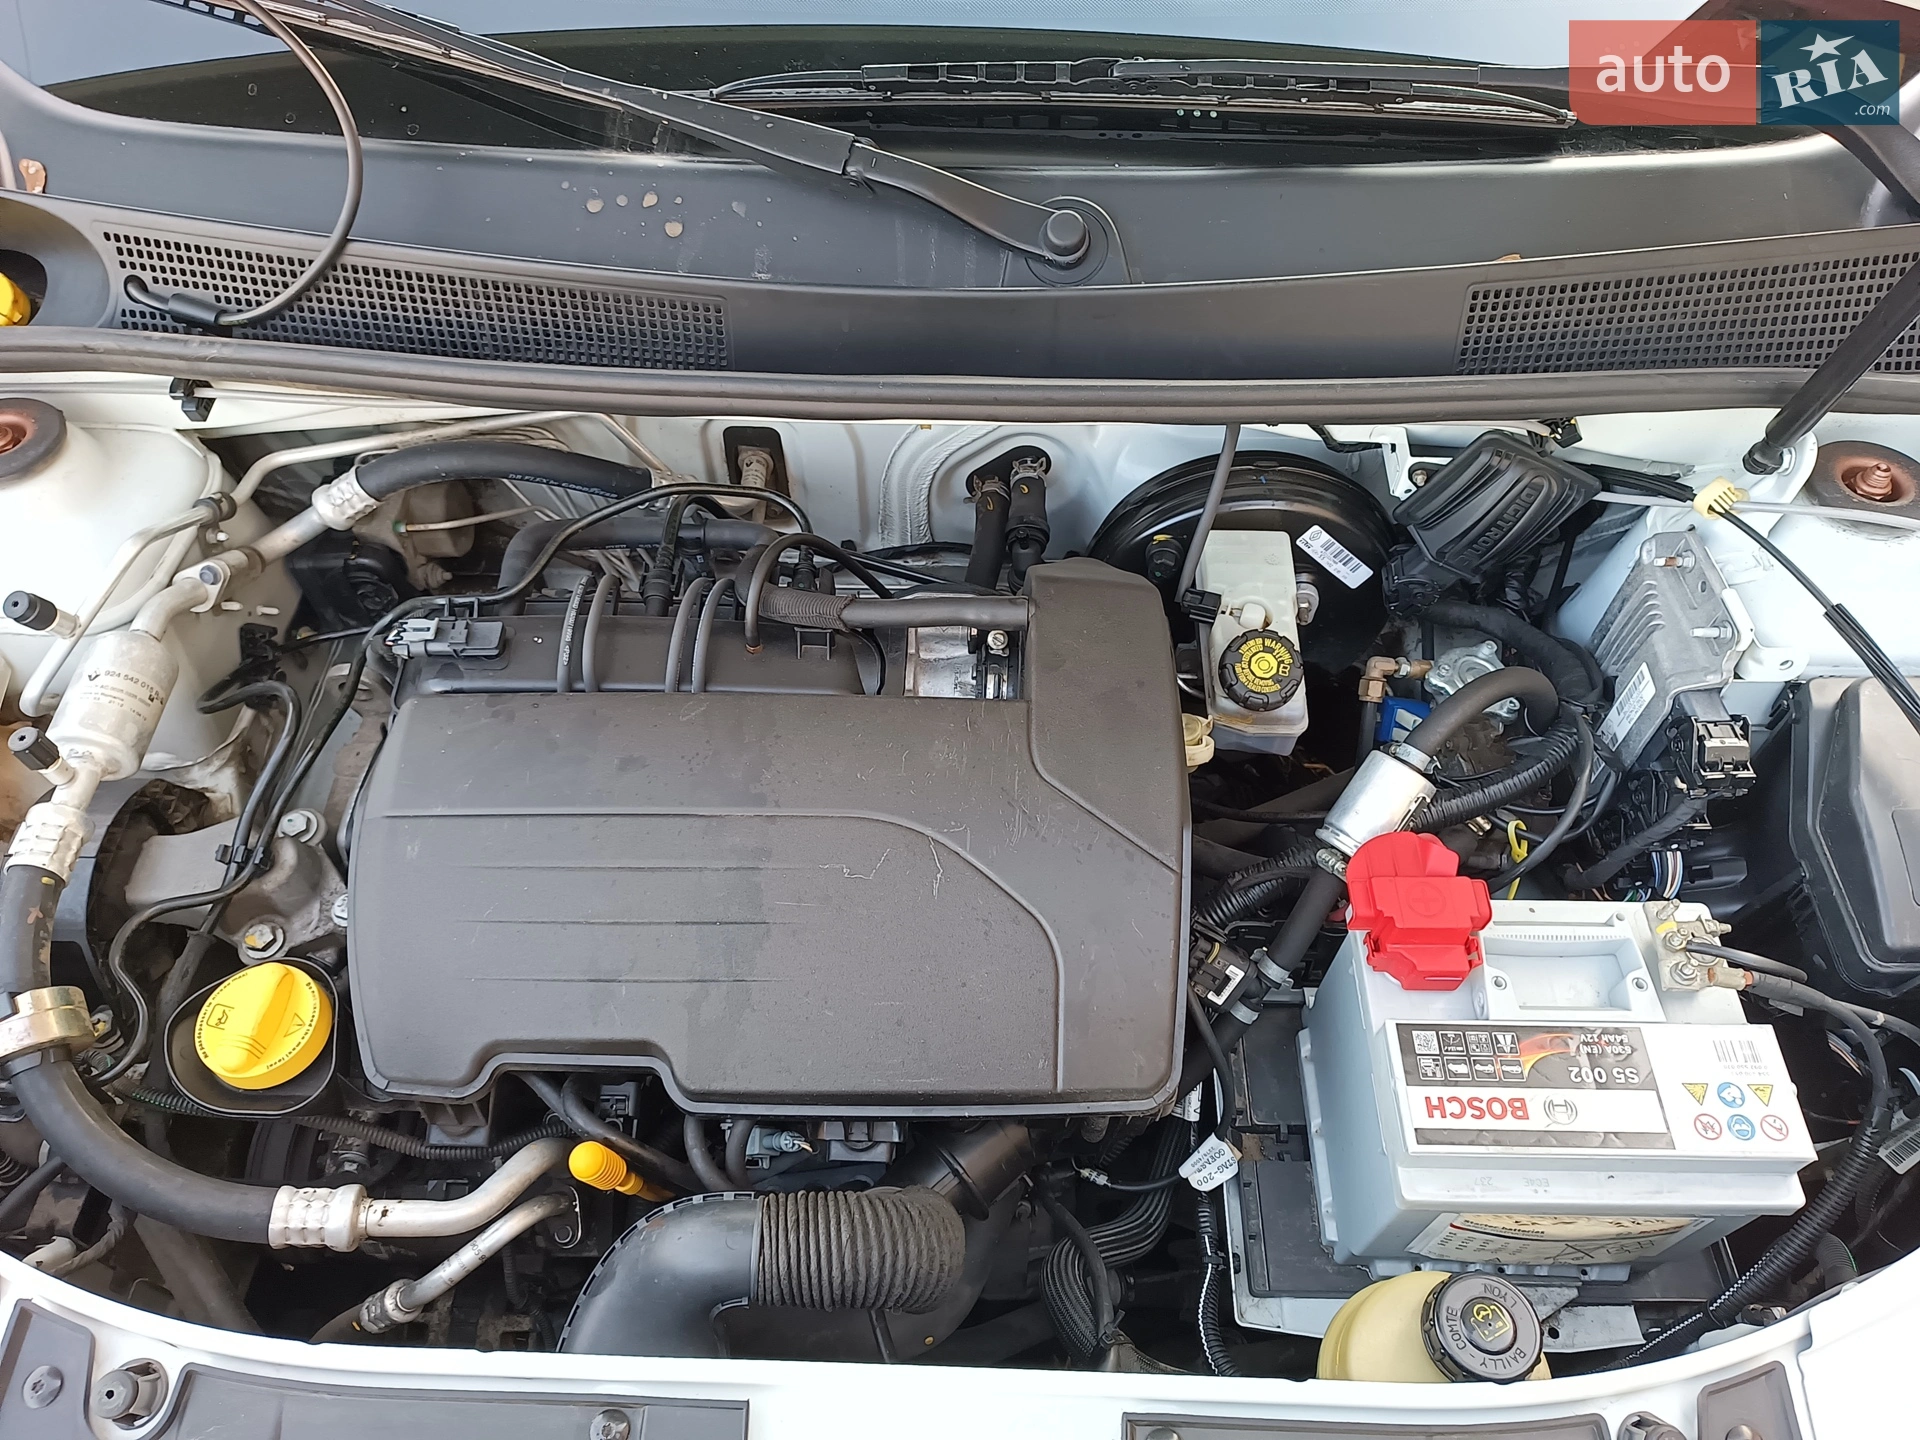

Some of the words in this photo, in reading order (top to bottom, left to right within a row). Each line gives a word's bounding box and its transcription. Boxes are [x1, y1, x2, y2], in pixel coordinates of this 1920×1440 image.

[1265, 638, 1293, 664] WARNING
[123, 674, 139, 684] 542
[301, 1028, 310, 1040] the
[1580, 1034, 1598, 1042] 12V
[1604, 1034, 1629, 1043] 54Ah
[1580, 1044, 1602, 1054] (EN)
[1606, 1045, 1632, 1054] 530A
[266, 1057, 285, 1069] level
[1567, 1066, 1606, 1083] 002
[1613, 1067, 1640, 1084] S5
[1425, 1096, 1529, 1120] BOSCH
[1197, 1156, 1236, 1186] STAG-200
[1474, 1177, 1493, 1186] 237
[1483, 1283, 1518, 1309] LYON
[1447, 1306, 1466, 1350] COMTE
[1479, 1347, 1527, 1371] BAILLY
